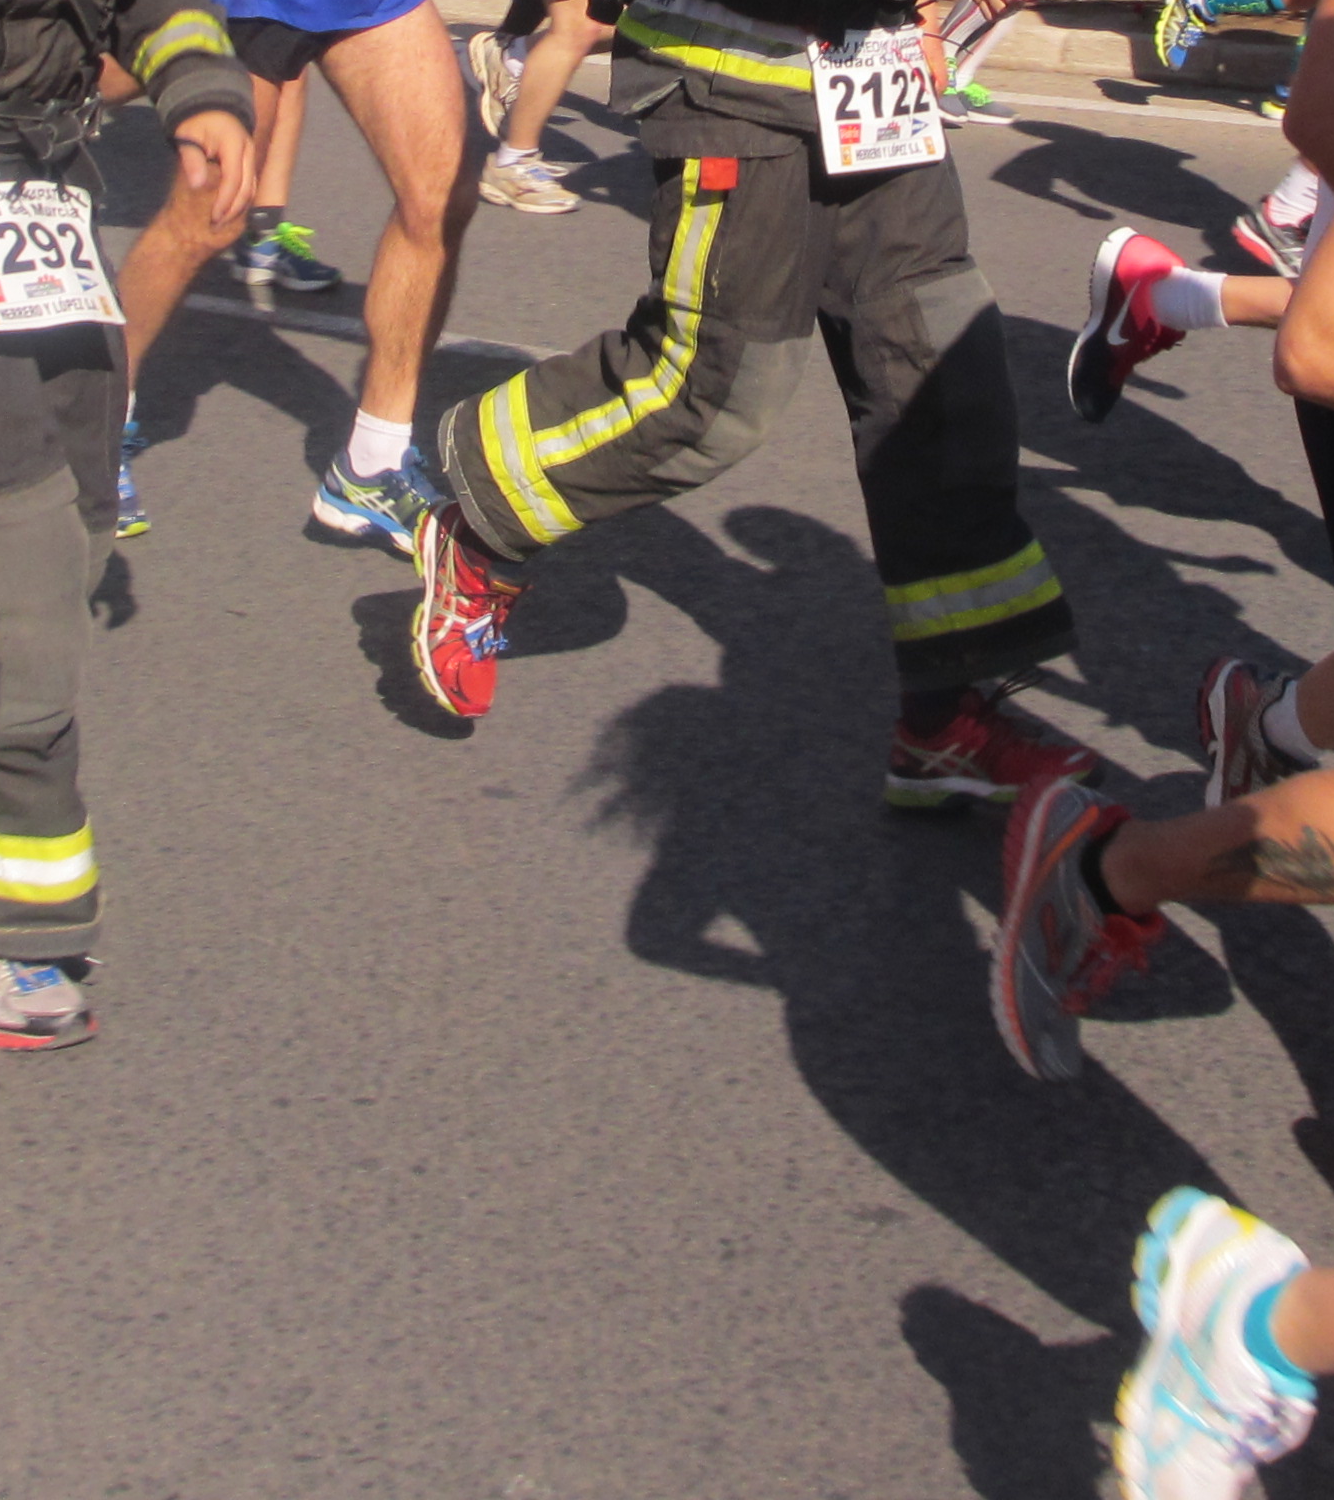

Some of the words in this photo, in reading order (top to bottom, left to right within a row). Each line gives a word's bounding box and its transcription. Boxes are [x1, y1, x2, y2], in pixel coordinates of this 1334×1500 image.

[819, 54, 874, 70] Ciudad
[829, 67, 931, 122] 2122
[31, 203, 79, 219] Murcia
